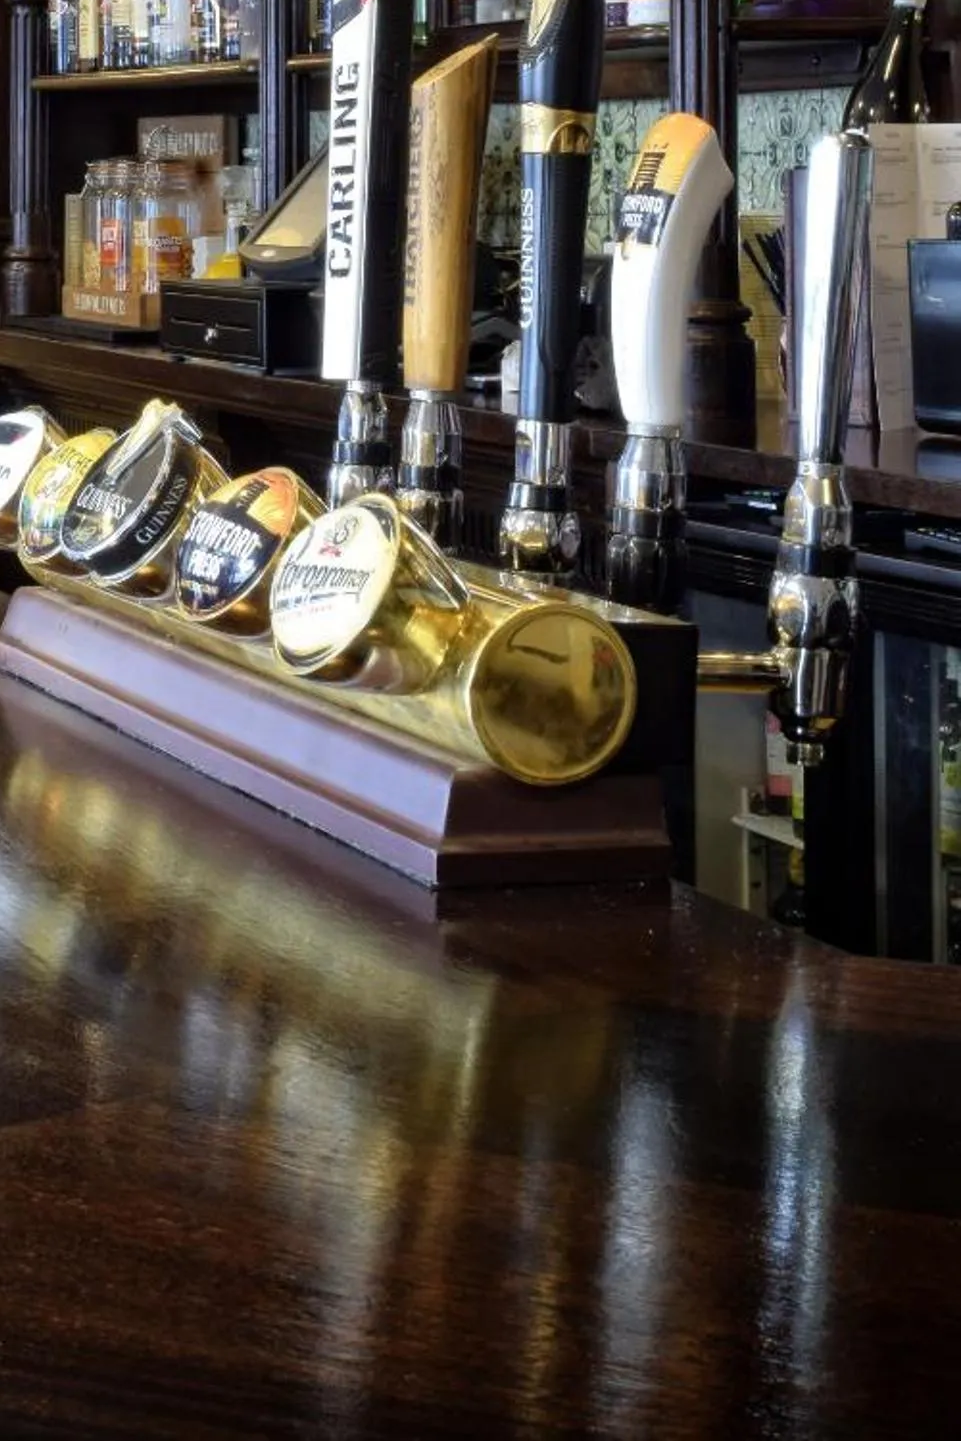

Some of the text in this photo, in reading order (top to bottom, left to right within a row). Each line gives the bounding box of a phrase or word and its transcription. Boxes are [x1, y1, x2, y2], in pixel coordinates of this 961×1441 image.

[328, 61, 360, 278] CARLING
[519, 186, 535, 330] GUINNESS
[135, 476, 189, 545] GUINNESS
